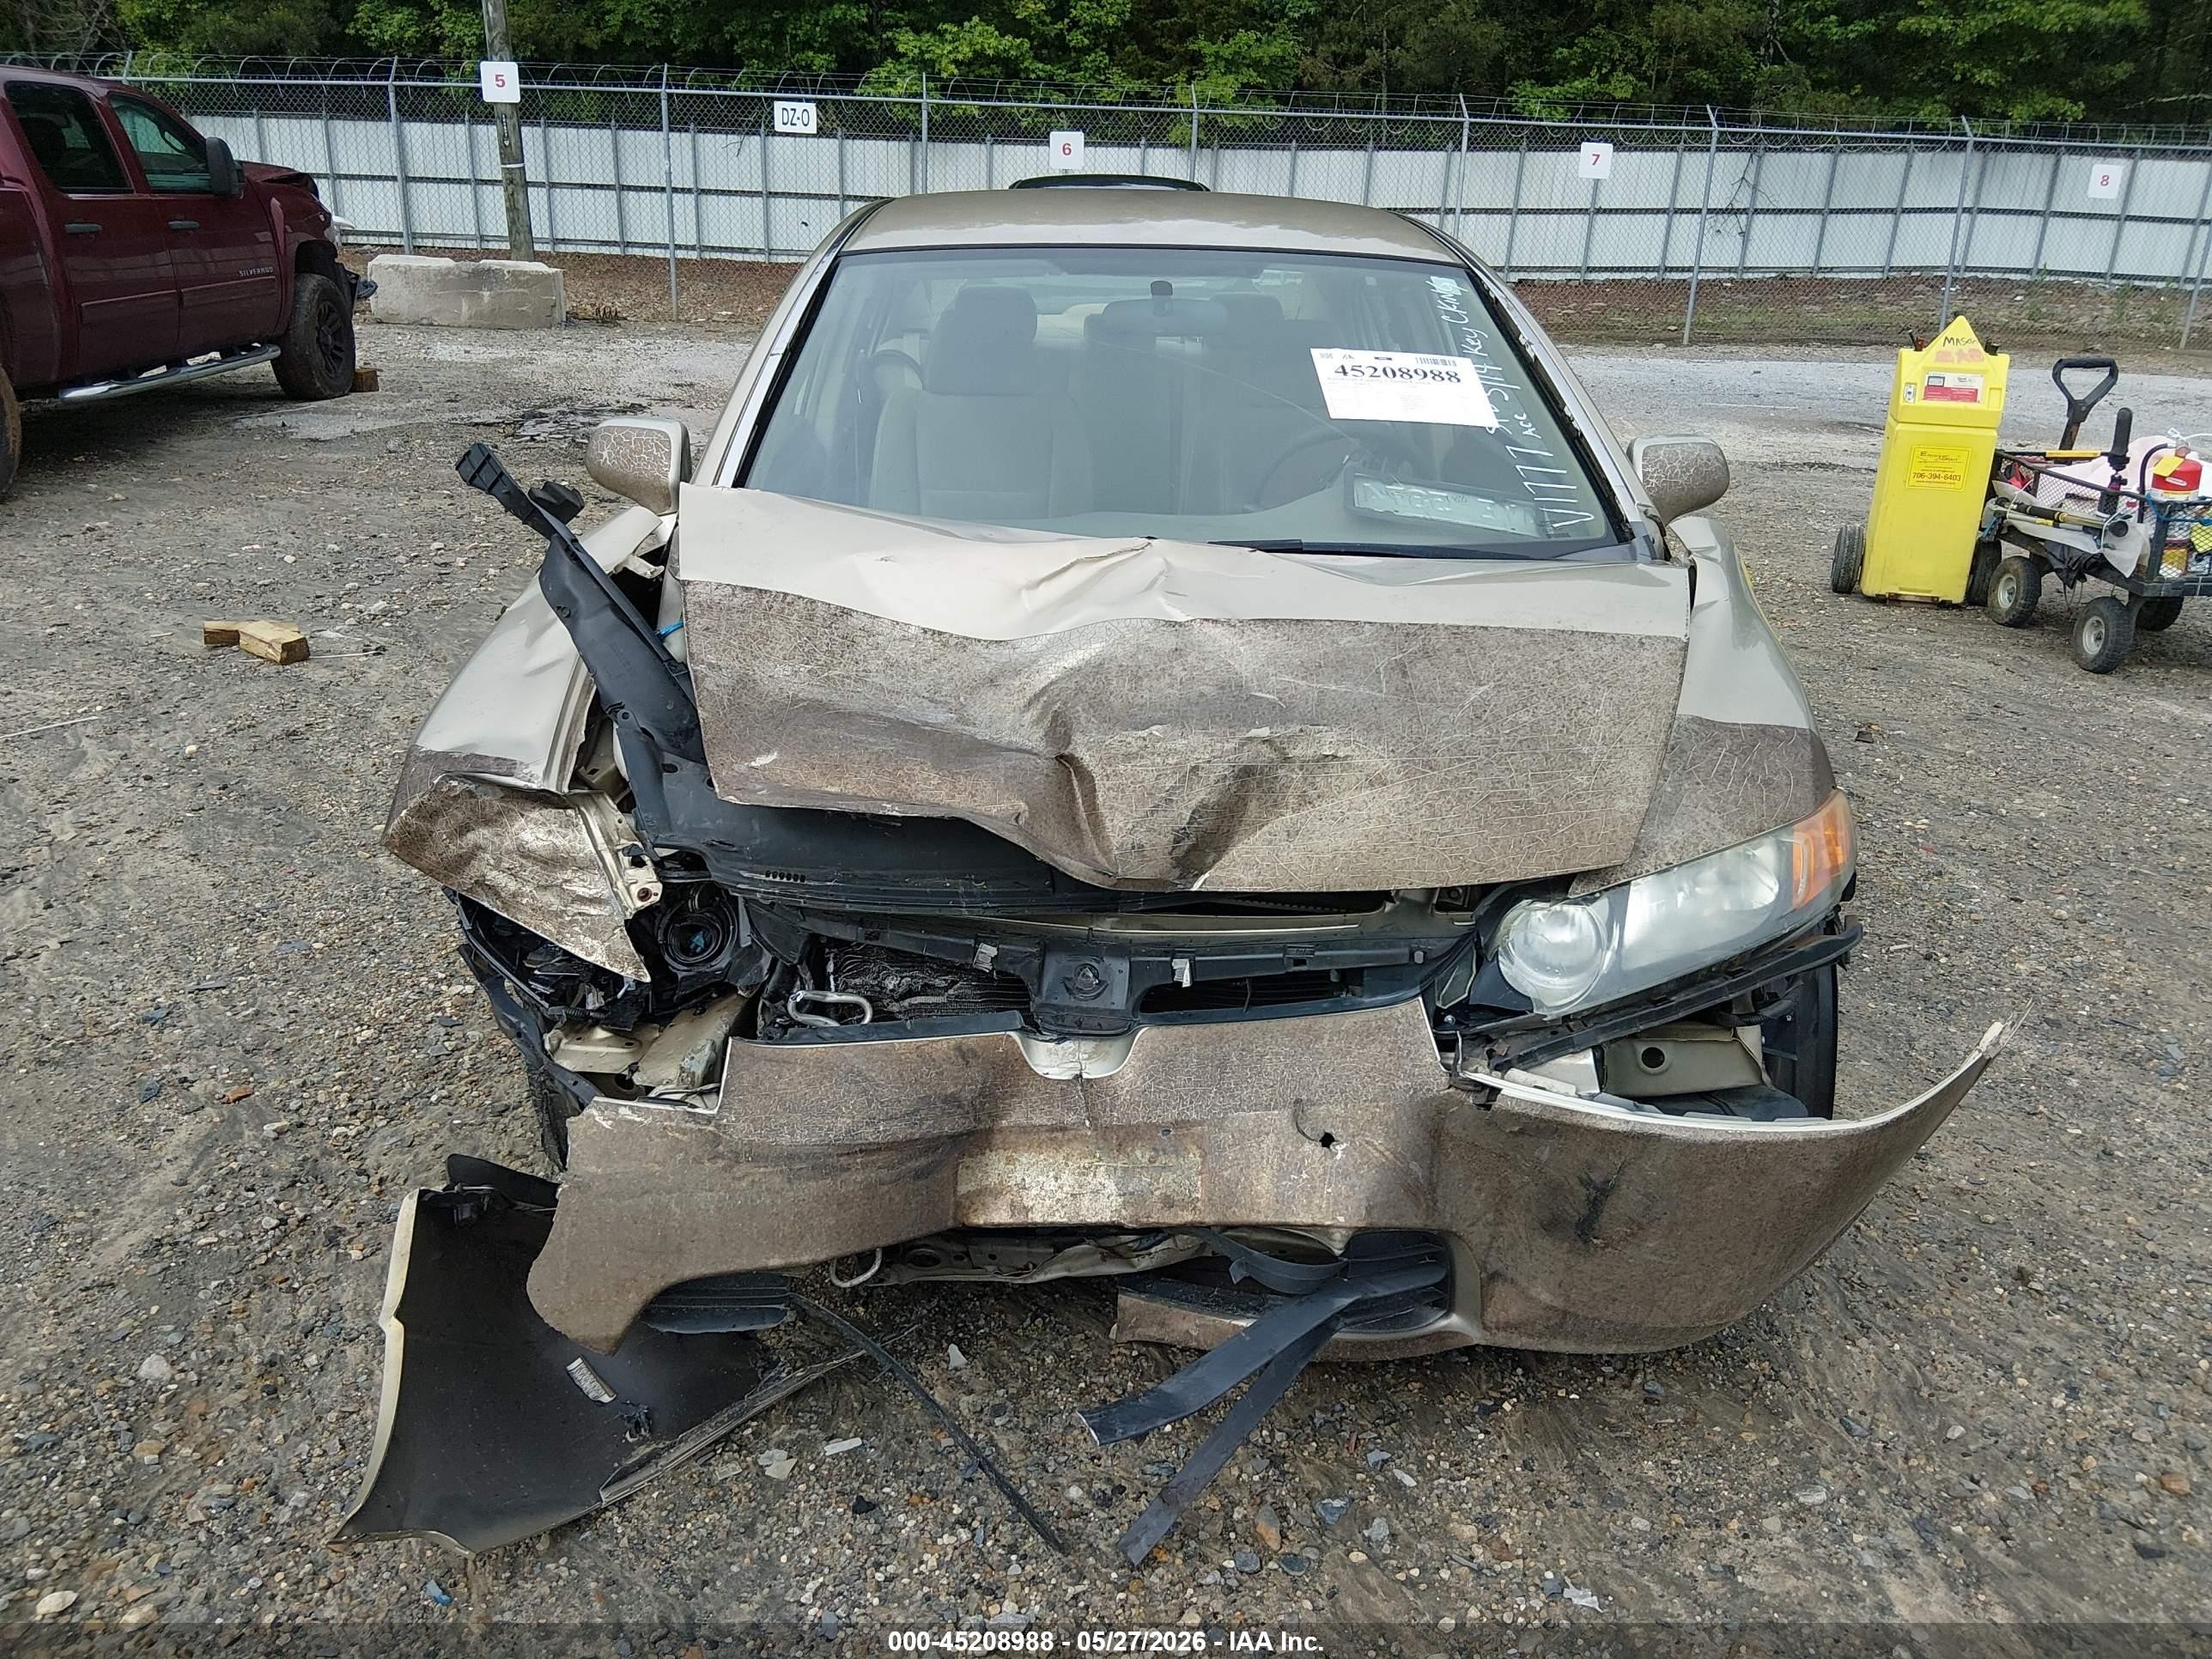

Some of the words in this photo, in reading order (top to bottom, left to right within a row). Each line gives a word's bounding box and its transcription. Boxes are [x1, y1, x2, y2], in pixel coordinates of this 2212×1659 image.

[495, 74, 506, 88] 5
[1062, 143, 1072, 155] 6
[1592, 153, 1601, 166] 7
[2100, 174, 2110, 186] 8
[239, 266, 274, 277] SILVERADO
[1334, 364, 1462, 383] 45208988
